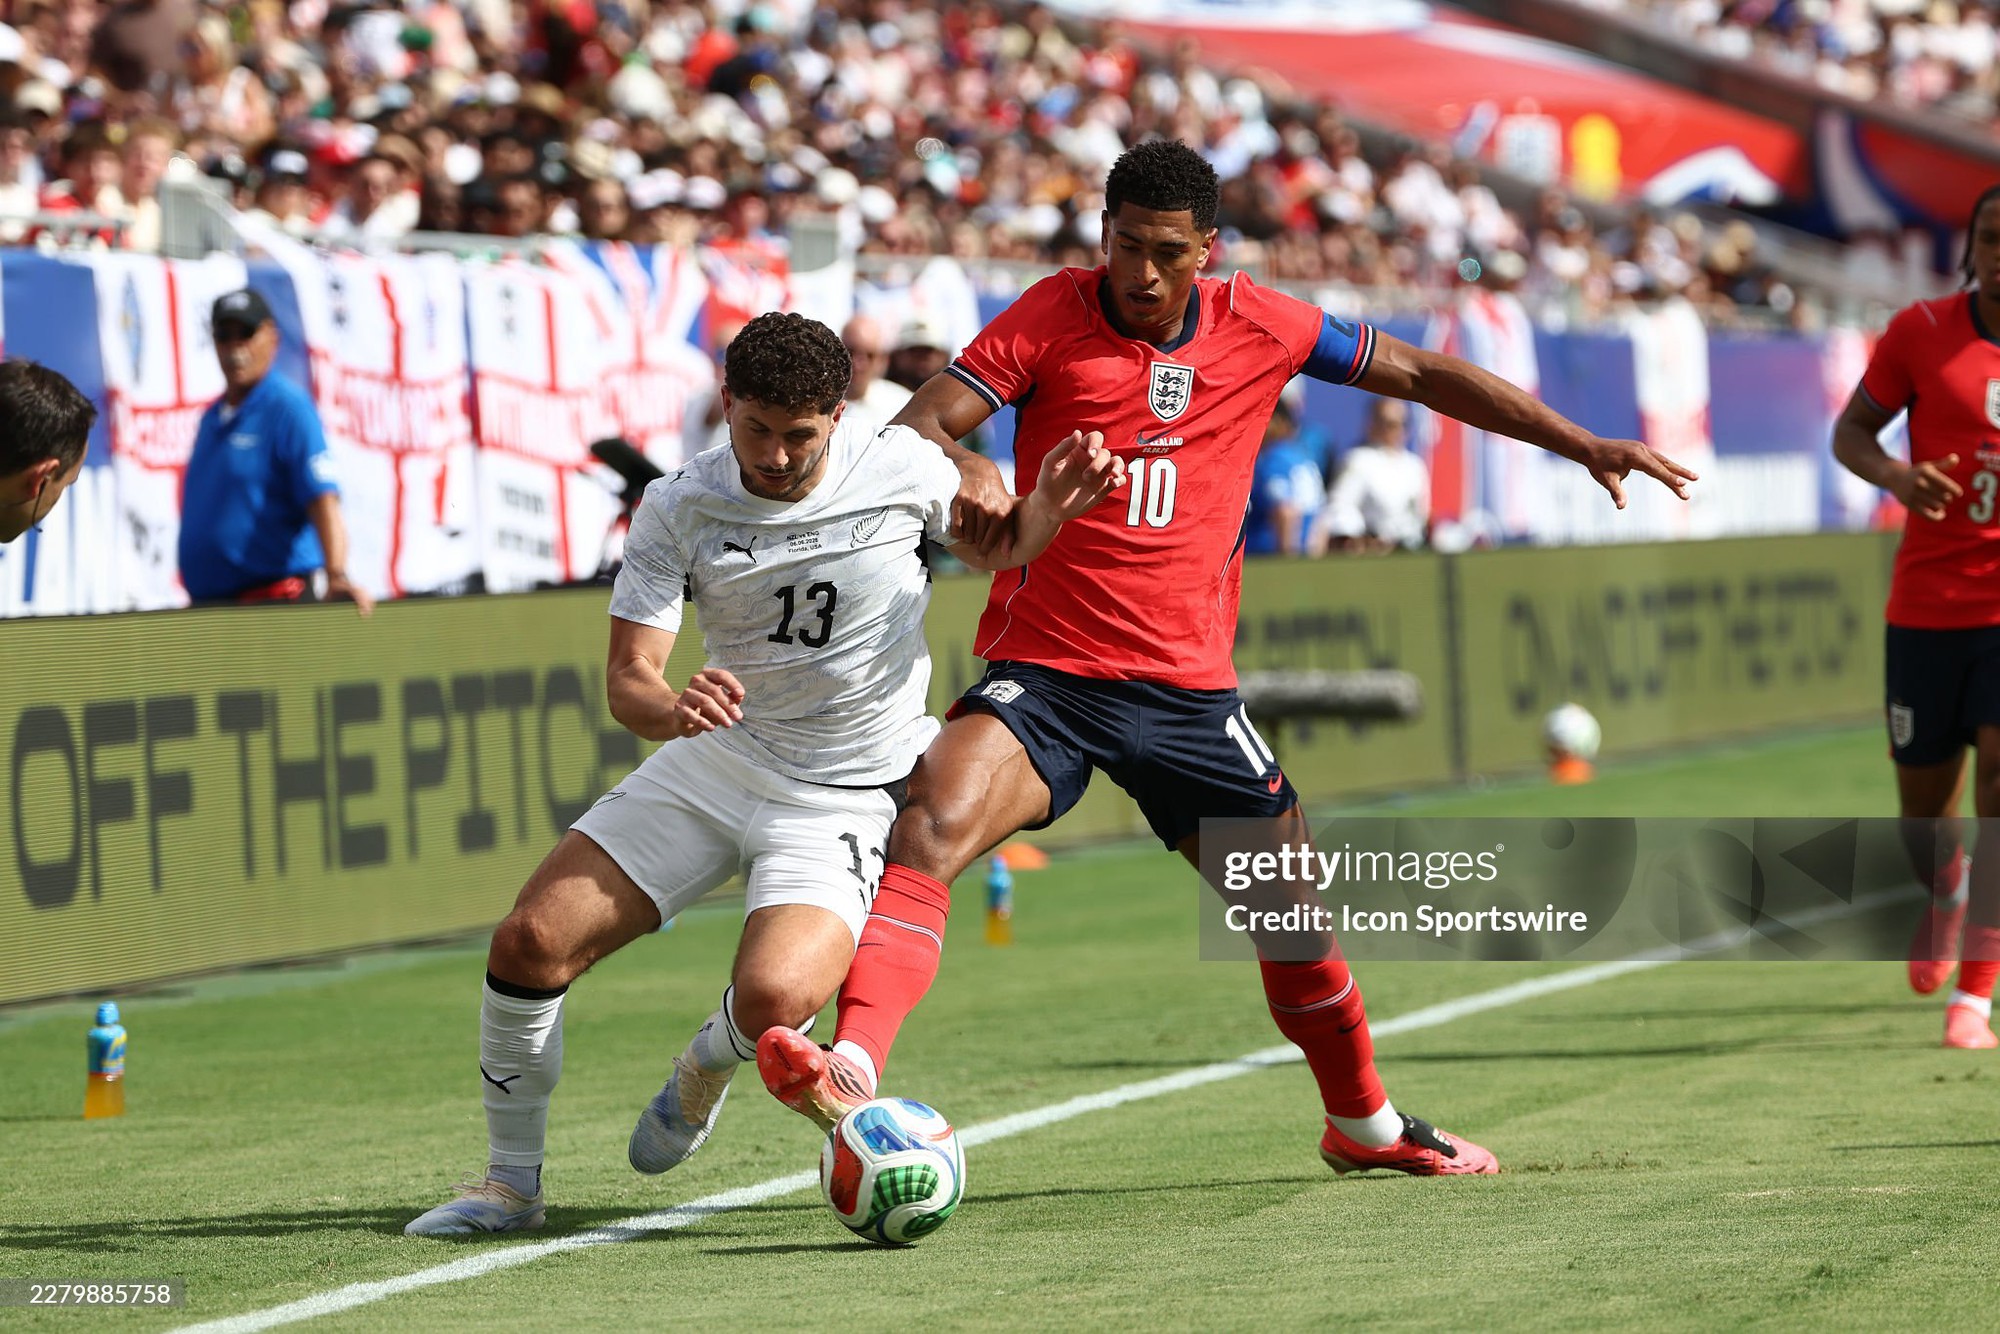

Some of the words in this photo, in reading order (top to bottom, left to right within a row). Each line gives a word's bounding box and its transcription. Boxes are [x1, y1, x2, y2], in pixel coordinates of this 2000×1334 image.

[1126, 457, 1178, 529] 10
[789, 537, 819, 547] 06.06.2026
[810, 543, 823, 551] USA
[767, 580, 838, 649] 13
[10, 692, 197, 911] OFF
[215, 680, 390, 881] THE
